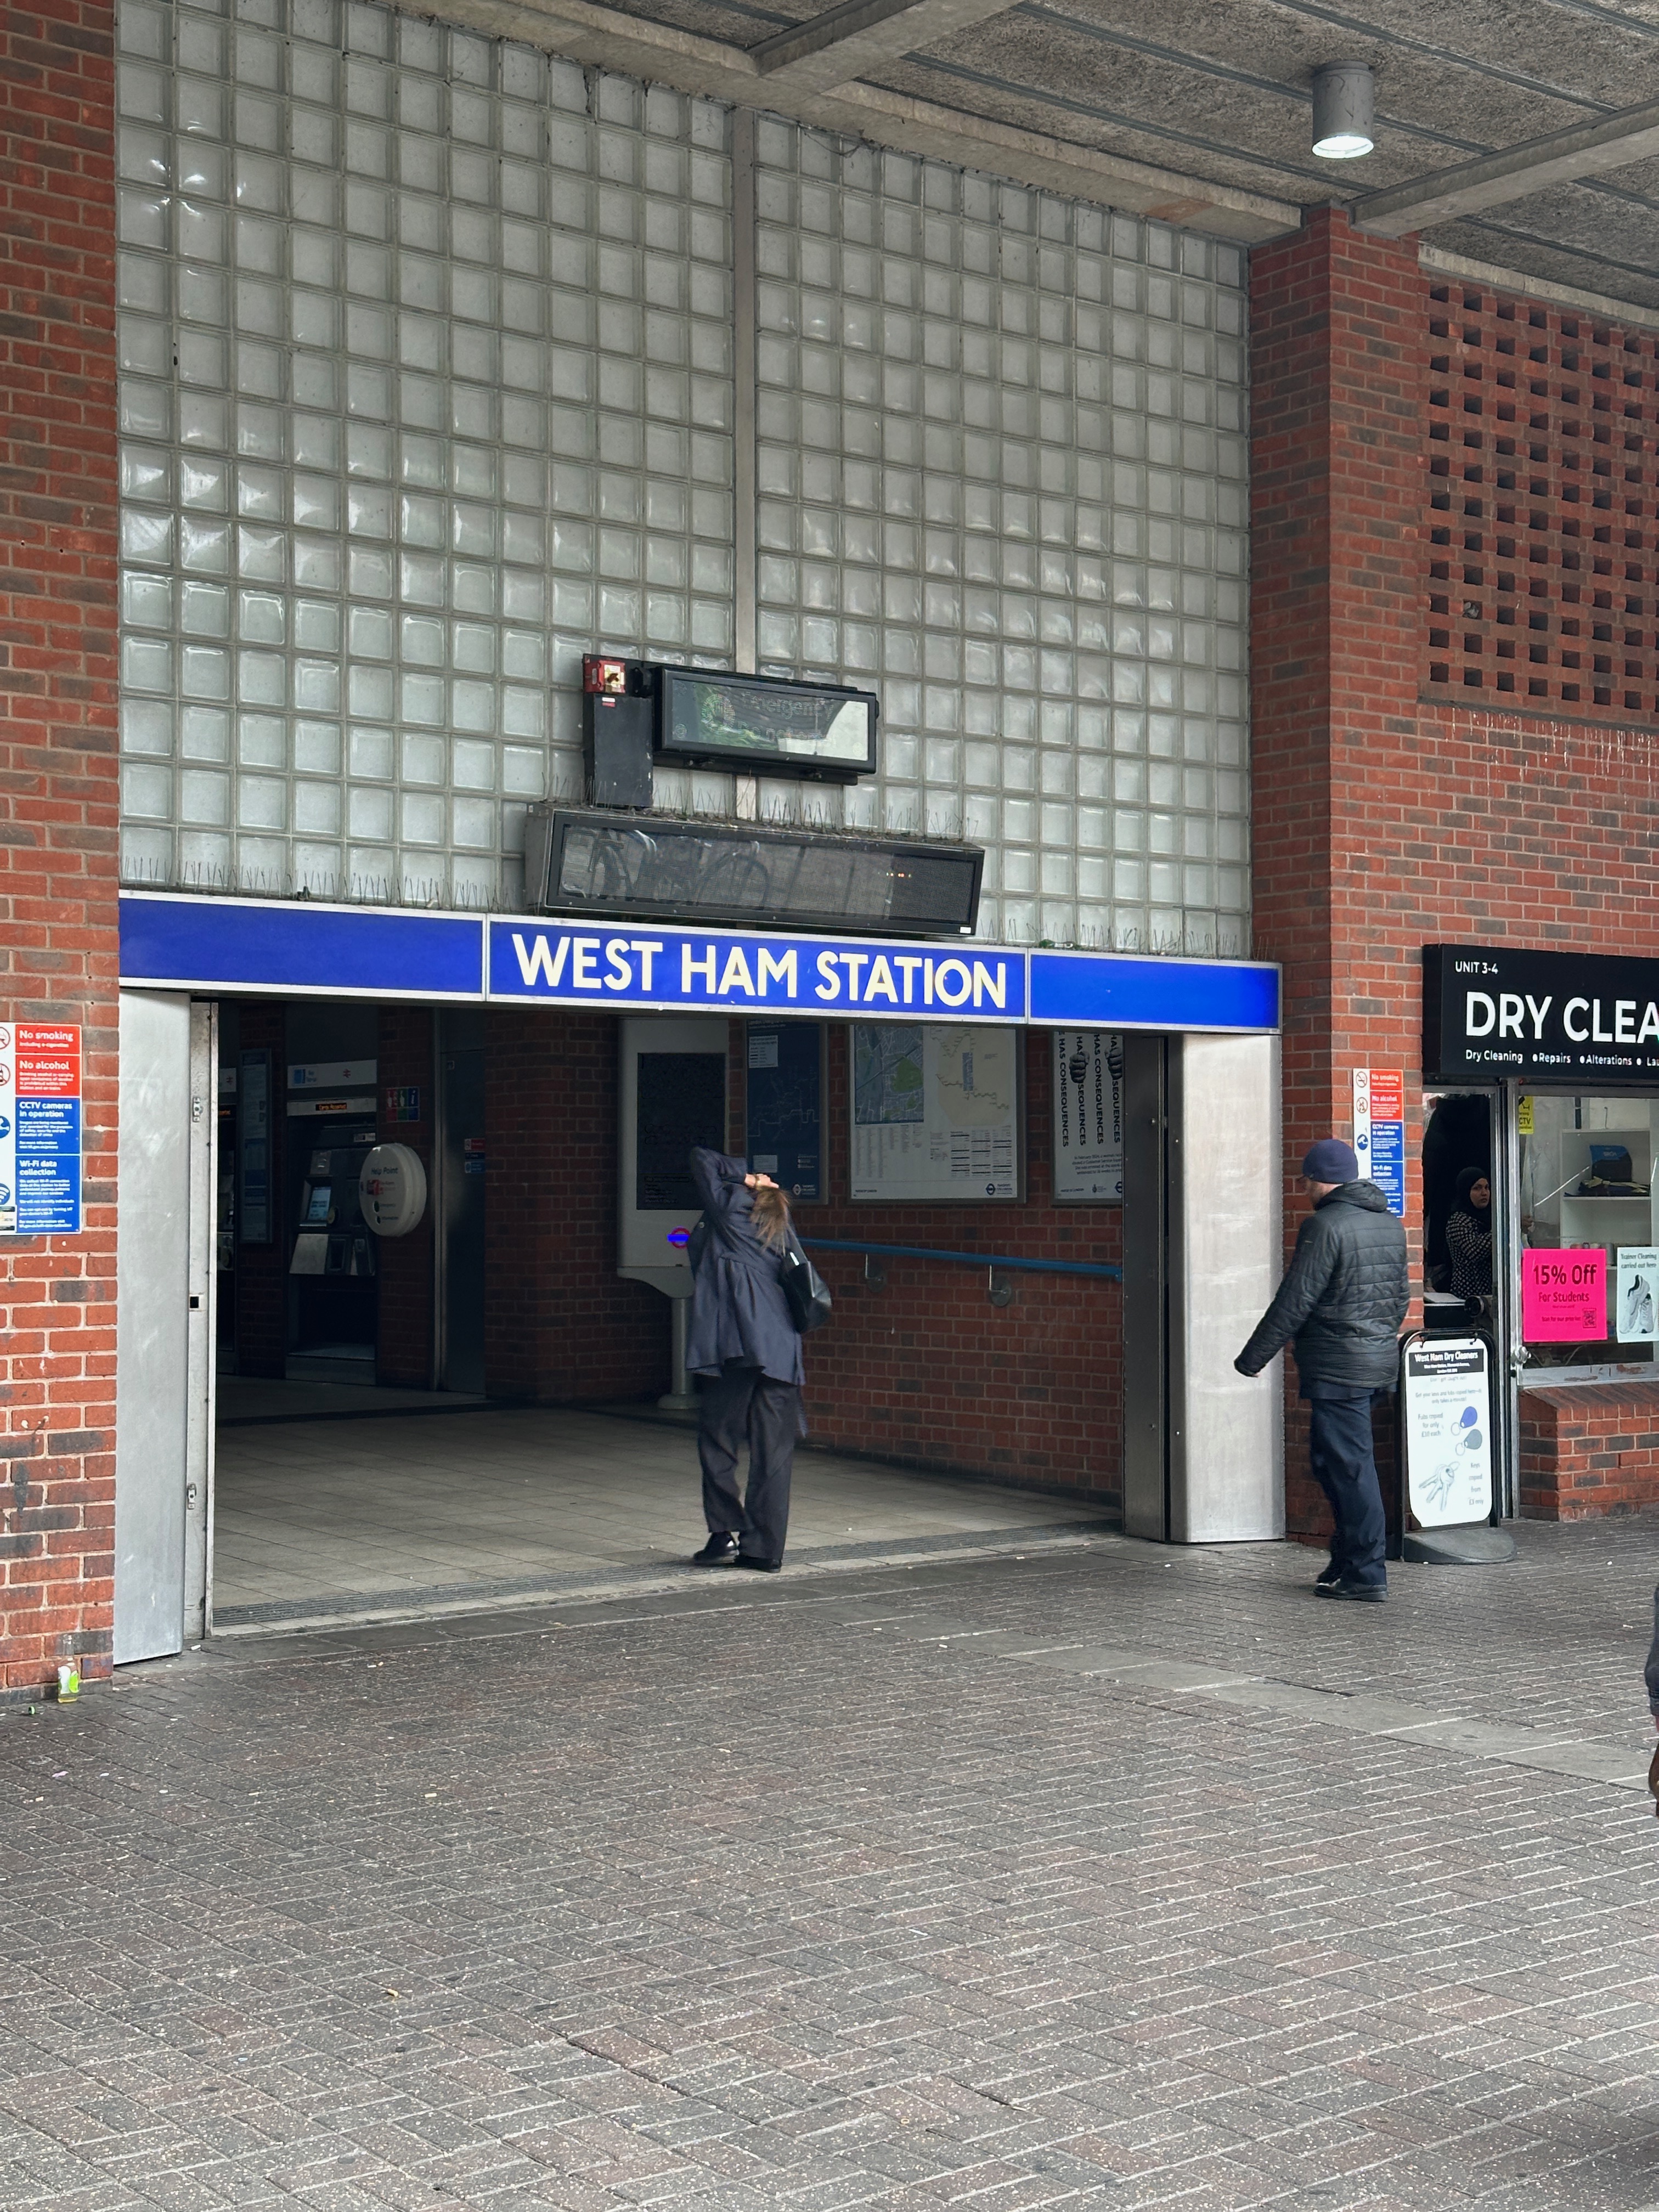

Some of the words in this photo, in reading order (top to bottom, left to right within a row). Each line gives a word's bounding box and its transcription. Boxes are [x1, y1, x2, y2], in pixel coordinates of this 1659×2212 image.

[511, 934, 663, 991] WEST
[681, 943, 798, 998] HAM
[815, 951, 1006, 1008] STATION
[1455, 961, 1480, 973] UNIT
[1466, 991, 1553, 1040] DRY
[19, 1030, 33, 1039] No
[35, 1031, 74, 1042] smoking
[19, 1060, 34, 1069] No
[35, 1060, 70, 1070] alcohol
[1465, 1049, 1482, 1062] Dry
[1483, 1050, 1523, 1064] Cleaning
[1539, 1052, 1571, 1065] Repairs
[1585, 1054, 1632, 1066] Alterations
[1059, 1062, 1069, 1147] CONSEQUENCES
[1094, 1059, 1104, 1144] CONSEQUENCES
[28, 1110, 64, 1118] operation
[1077, 1083, 1086, 1146] SEQUENCES
[1112, 1080, 1121, 1143] SEQUENCES
[1533, 1265, 1567, 1285] 15%
[1572, 1263, 1597, 1285] Off
[1538, 1291, 1551, 1302] For
[1553, 1291, 1590, 1302] Students
[1414, 1353, 1430, 1362] West
[1430, 1353, 1443, 1361] Ham
[1444, 1352, 1454, 1362] Dry
[1455, 1351, 1479, 1360] Cleaners
